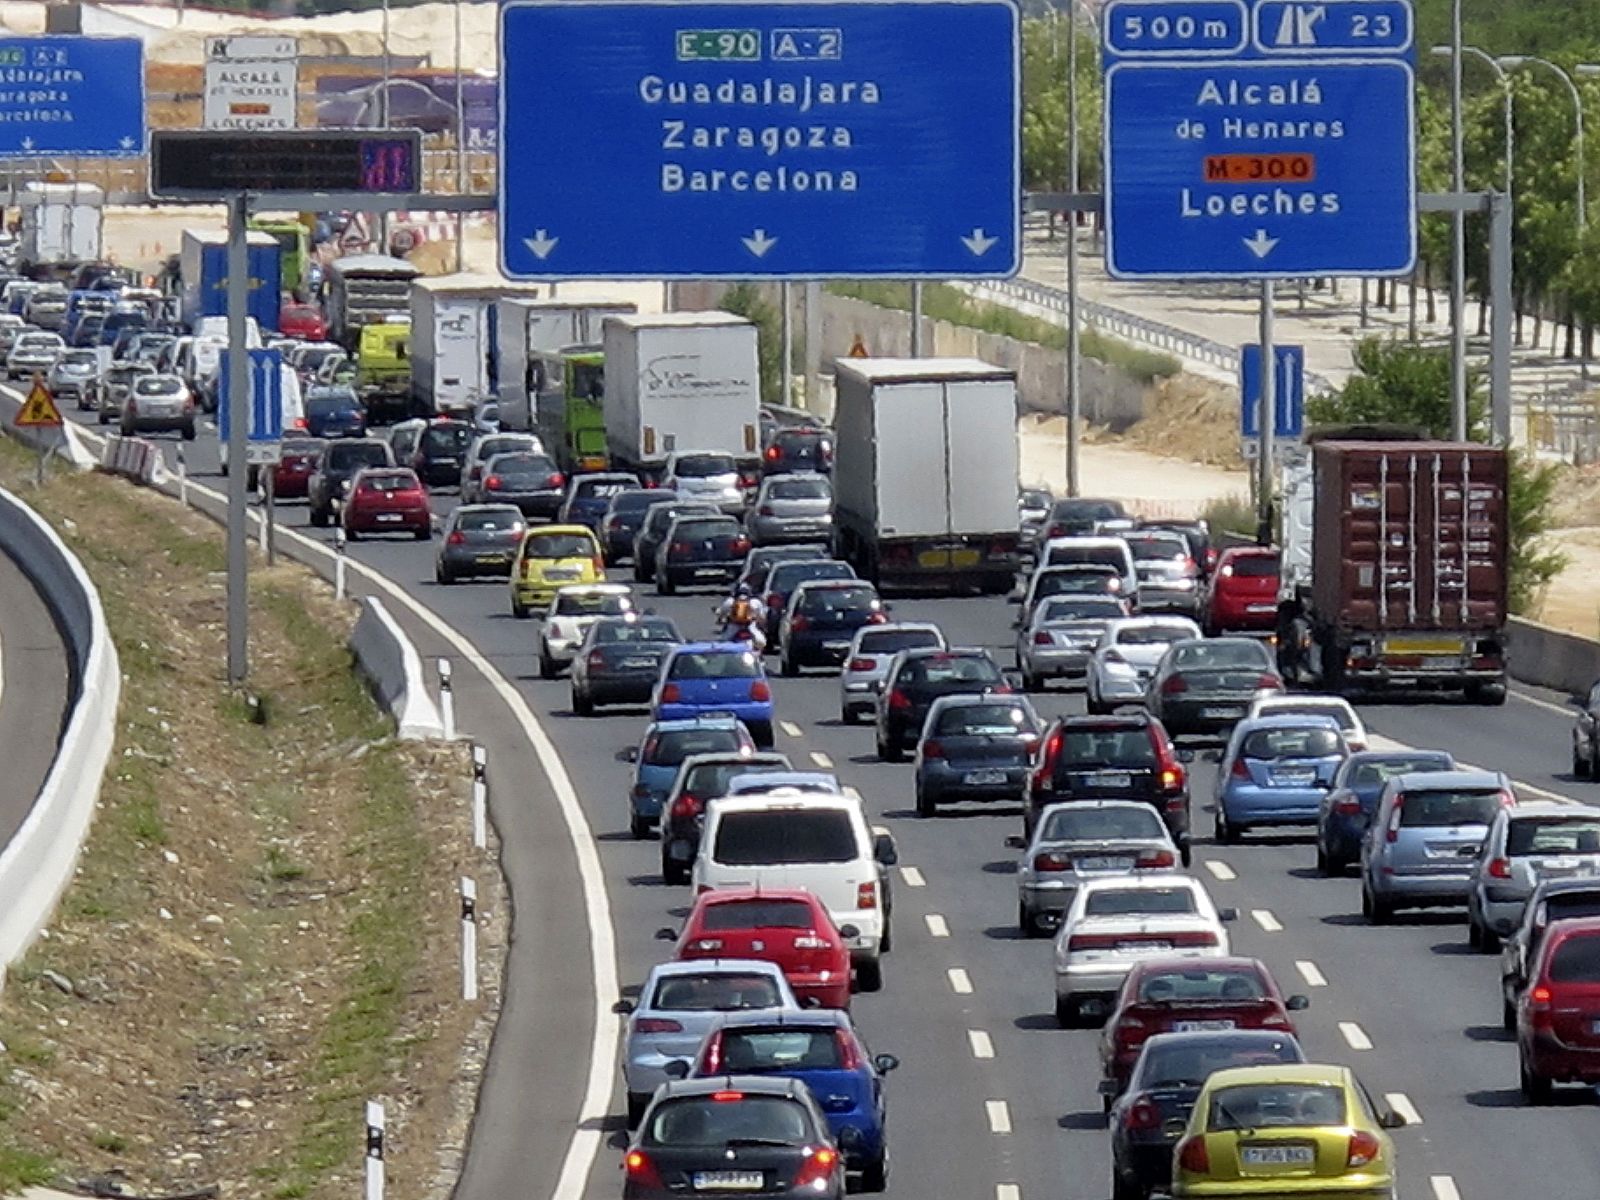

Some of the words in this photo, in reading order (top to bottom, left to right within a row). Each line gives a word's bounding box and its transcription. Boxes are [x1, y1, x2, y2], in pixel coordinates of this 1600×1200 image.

[1352, 15, 1392, 37] 23
[681, 33, 757, 57] E-90
[776, 33, 837, 56] A-2
[639, 75, 879, 112] Guadalajara
[1198, 79, 1322, 106] Alcalá
[662, 120, 852, 155] Zaragoza
[1176, 119, 1206, 139] de
[1223, 119, 1344, 139] Henares
[661, 164, 858, 192] Barcelona
[1208, 159, 1310, 179] M-300
[1181, 189, 1341, 217] Loeches
